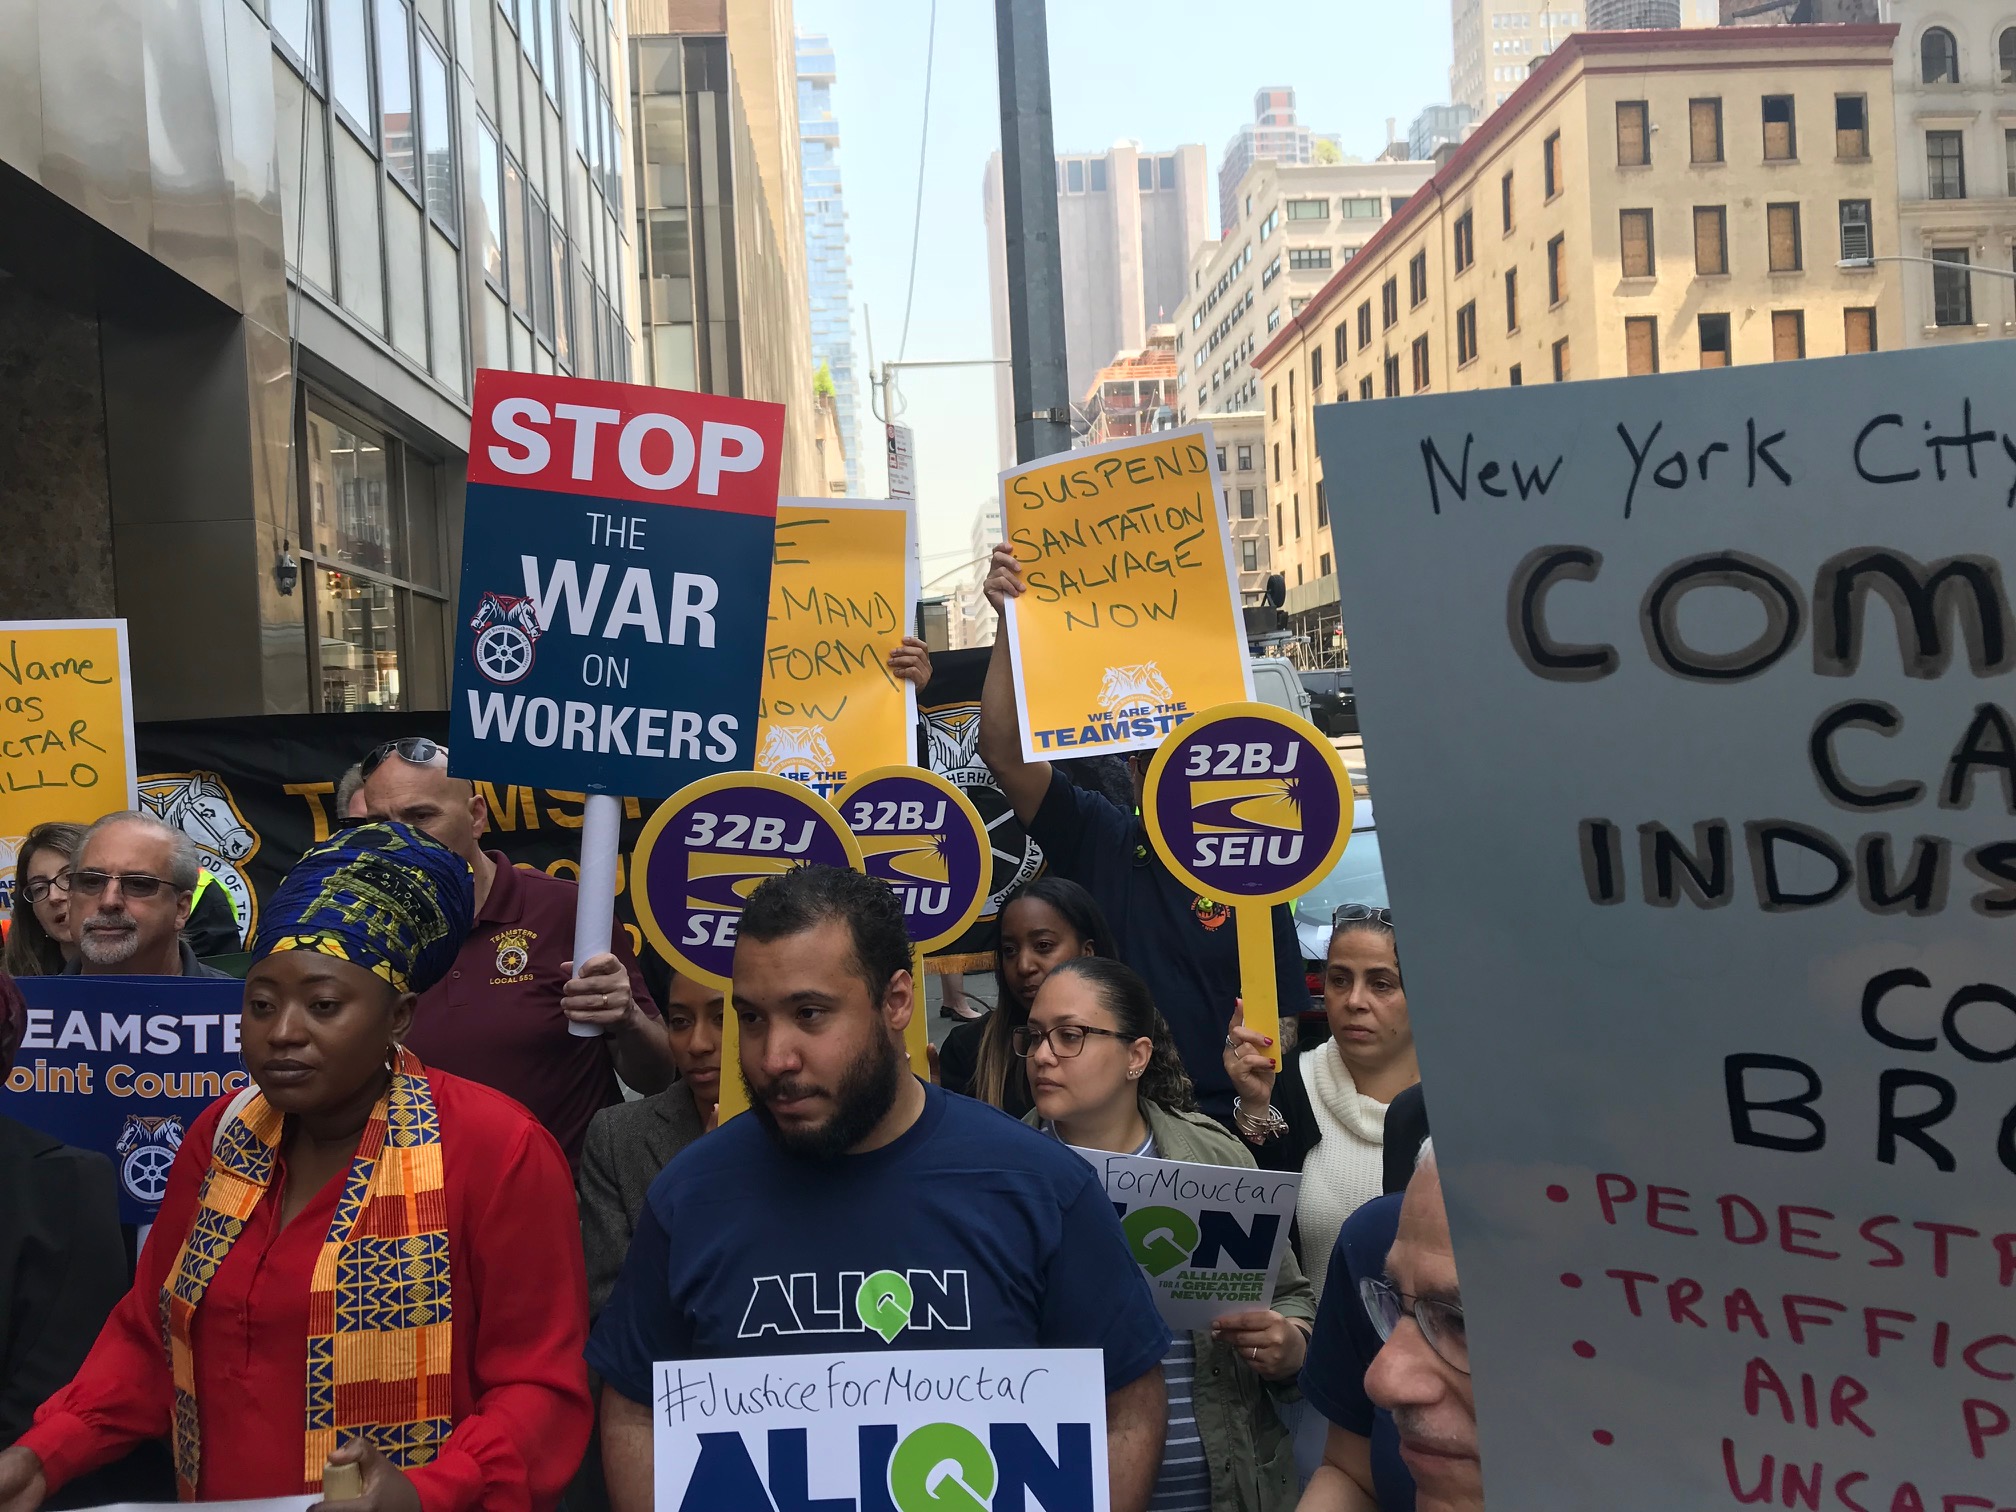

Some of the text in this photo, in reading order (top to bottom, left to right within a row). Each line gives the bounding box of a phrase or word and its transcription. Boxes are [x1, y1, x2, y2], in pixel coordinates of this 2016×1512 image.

[488, 397, 764, 496] STOP
[1013, 445, 1208, 509] SUSPEND
[1420, 432, 1564, 515] New
[1617, 416, 1793, 519] York
[586, 513, 647, 551] THE
[1011, 491, 1205, 563] SANITATION
[1027, 529, 1206, 602] SALVAGE
[520, 554, 719, 648] WAR
[767, 585, 897, 635] MAND
[1066, 589, 1178, 632] NOW
[581, 653, 630, 690] ON
[767, 639, 901, 693] FORM
[0, 696, 45, 722] as
[467, 689, 739, 763] WORKERS
[1088, 711, 1114, 723] WE
[1118, 707, 1151, 719] ARE
[1155, 701, 1188, 713] THE
[0, 719, 107, 759] CTAR
[1184, 741, 1300, 777] 32BJ
[815, 771, 848, 781] THE
[684, 812, 817, 854] 32BJ
[849, 800, 947, 832] 32BJ
[1192, 834, 1305, 868] SEIU
[224, 874, 243, 893] OF
[489, 928, 538, 944] TEAMSTERS
[489, 977, 518, 985] LOCAL
[20, 1008, 242, 1056] EAMSTE
[4, 1058, 257, 1099] oint Counc
[1158, 1280, 1264, 1292] FOR A GREATER
[1170, 1290, 1262, 1302] NEW YORK
[1176, 1270, 1267, 1282] ALLIANCE
[1744, 1356, 1876, 1437] AIR
